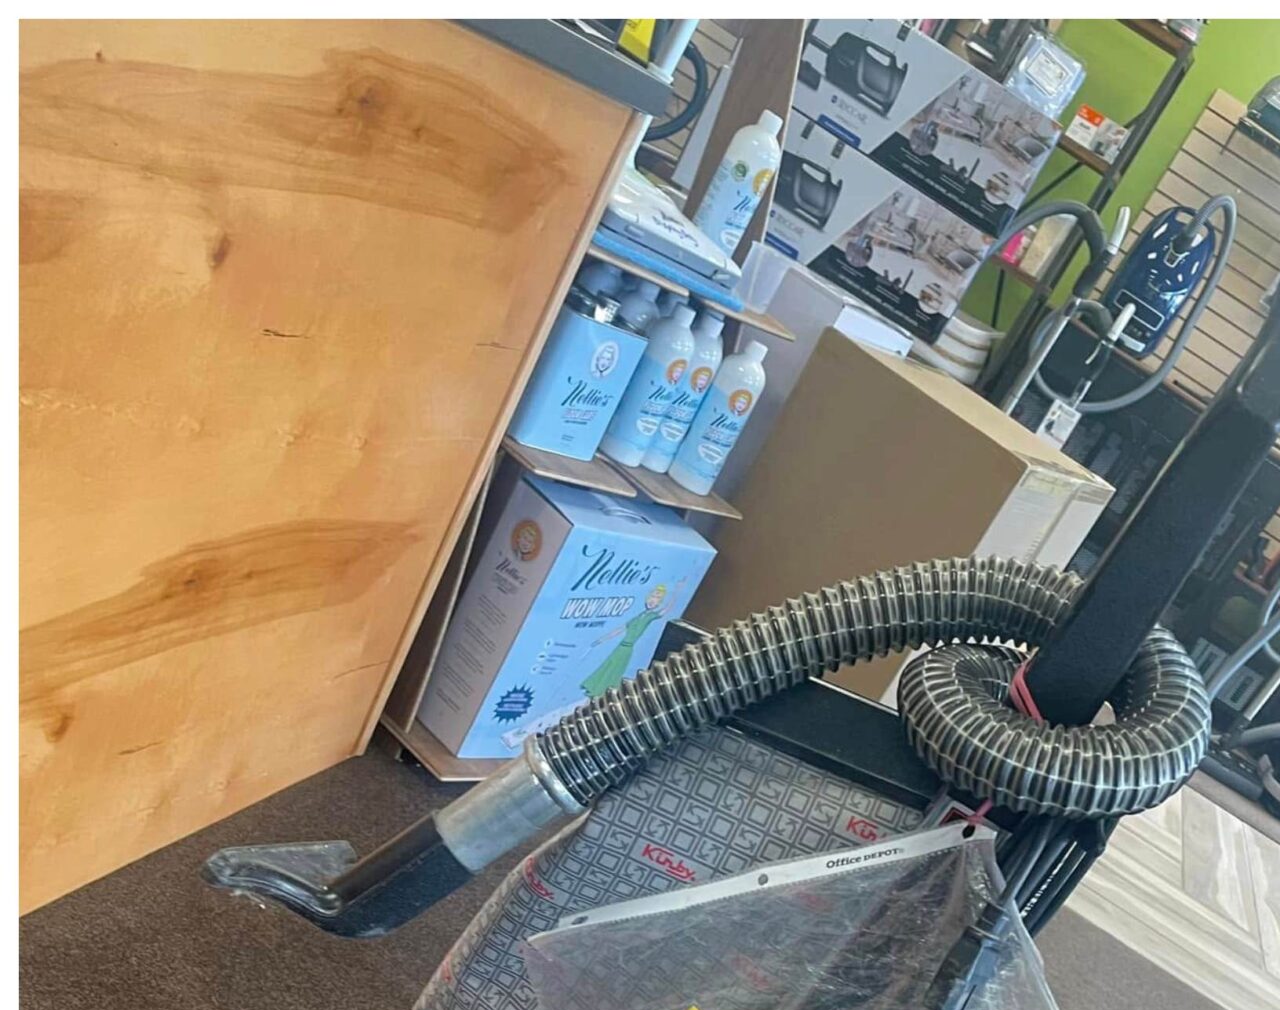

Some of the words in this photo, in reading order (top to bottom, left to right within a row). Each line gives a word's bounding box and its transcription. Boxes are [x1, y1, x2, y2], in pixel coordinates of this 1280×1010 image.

[571, 544, 661, 592] Nellie's
[560, 597, 605, 619] WOW
[596, 596, 635, 618] MOP
[640, 844, 694, 881] Kirby
[826, 857, 862, 869] Office
[864, 848, 899, 861] DEPOT
